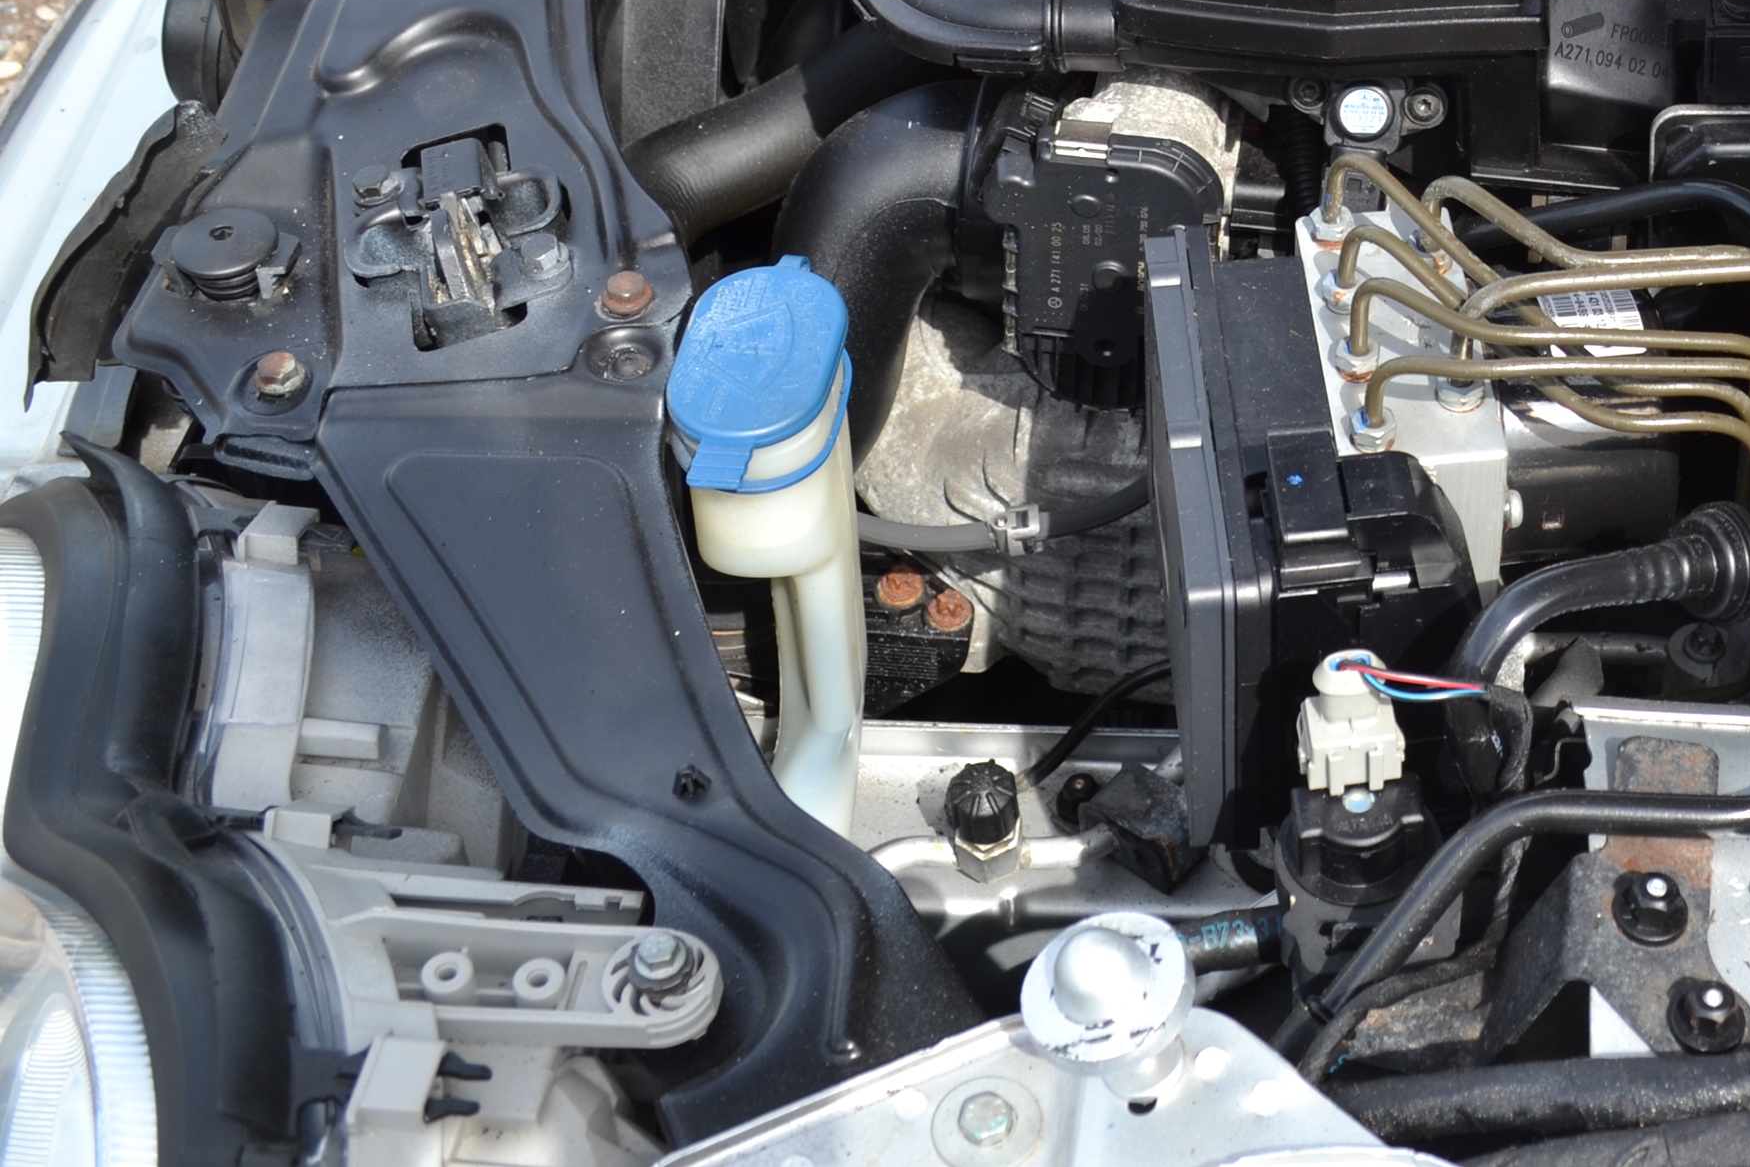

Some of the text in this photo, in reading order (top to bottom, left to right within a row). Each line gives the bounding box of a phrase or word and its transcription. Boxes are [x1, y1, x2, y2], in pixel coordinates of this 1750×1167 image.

[1554, 41, 1590, 63] A271
[1596, 50, 1623, 70] 094
[1629, 57, 1646, 75] 02
[1051, 222, 1062, 232] 25
[1051, 236, 1061, 247] 00
[1051, 251, 1060, 264] 141
[1050, 269, 1061, 284] 271
